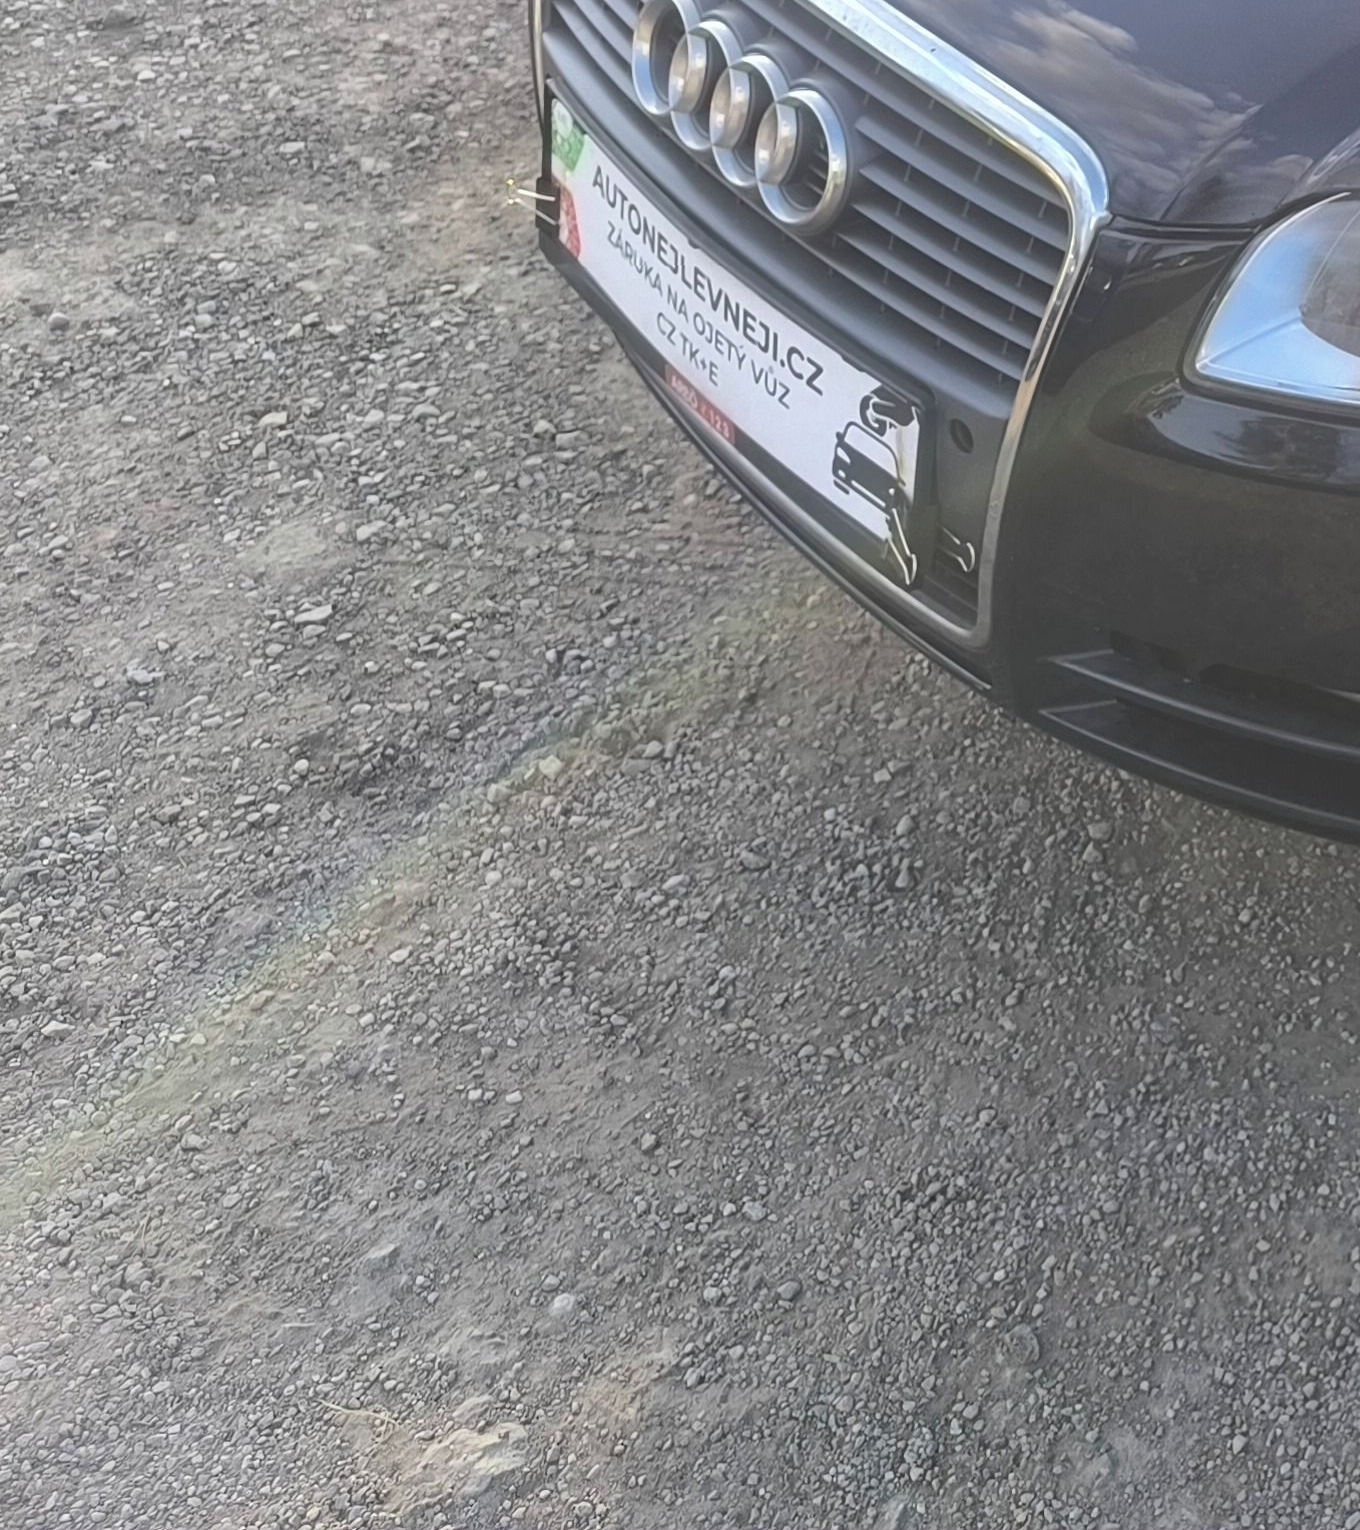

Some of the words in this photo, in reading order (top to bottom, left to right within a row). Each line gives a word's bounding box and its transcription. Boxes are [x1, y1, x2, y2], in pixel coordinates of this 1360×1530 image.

[592, 165, 826, 396] AUTONEJLEVNEJI.CZ
[607, 220, 663, 297] ZÁRUKA
[667, 283, 689, 324] NA
[693, 312, 748, 371] OJETÝ
[750, 359, 791, 411] VŮZ
[656, 311, 677, 346] CZ
